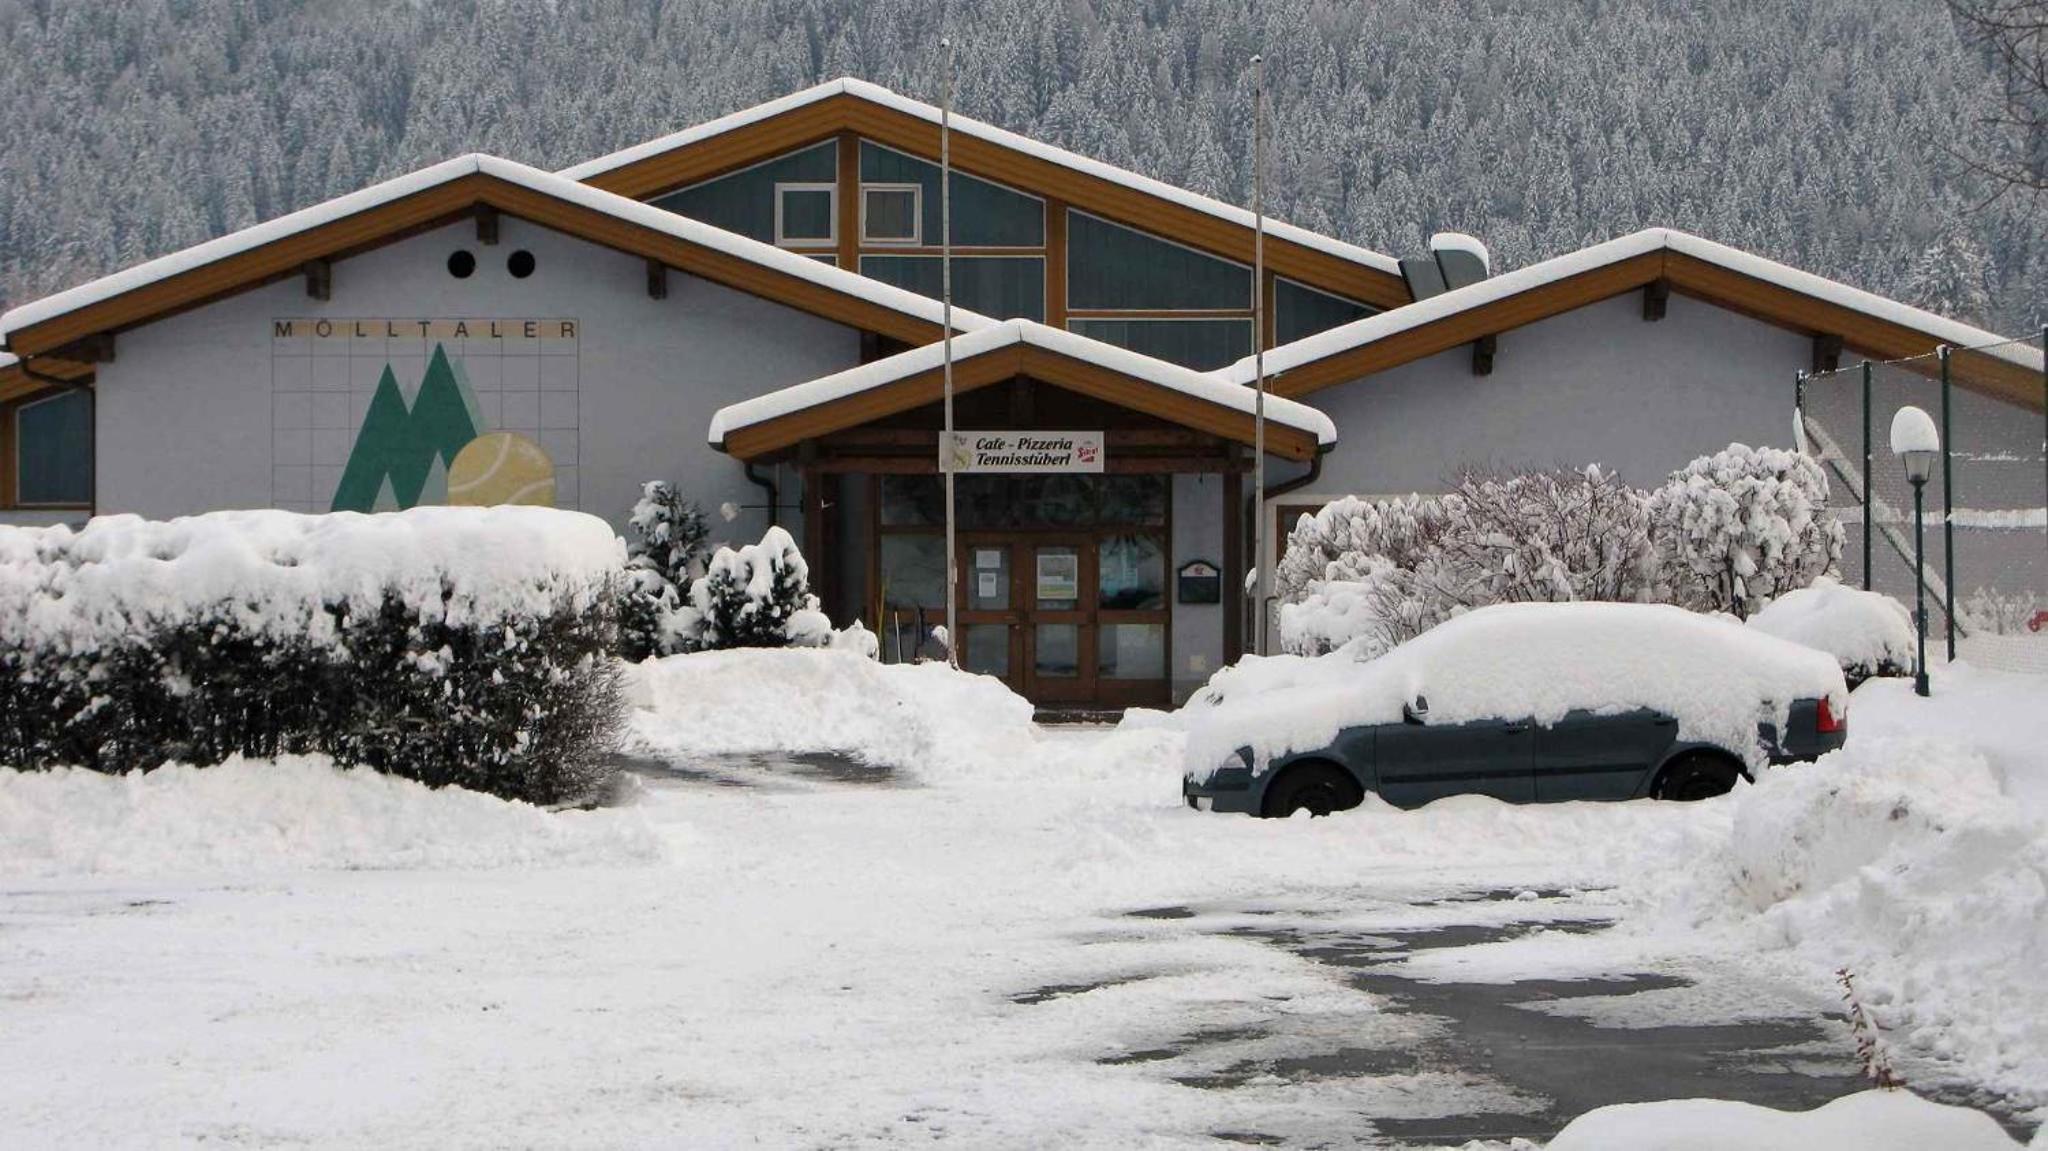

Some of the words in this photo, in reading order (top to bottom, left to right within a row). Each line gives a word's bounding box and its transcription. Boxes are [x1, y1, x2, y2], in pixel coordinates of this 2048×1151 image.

[275, 317, 576, 338] MÖLLTALER
[1017, 437, 1073, 450] Pizzeria
[976, 452, 1071, 466] Tennisstüberl
